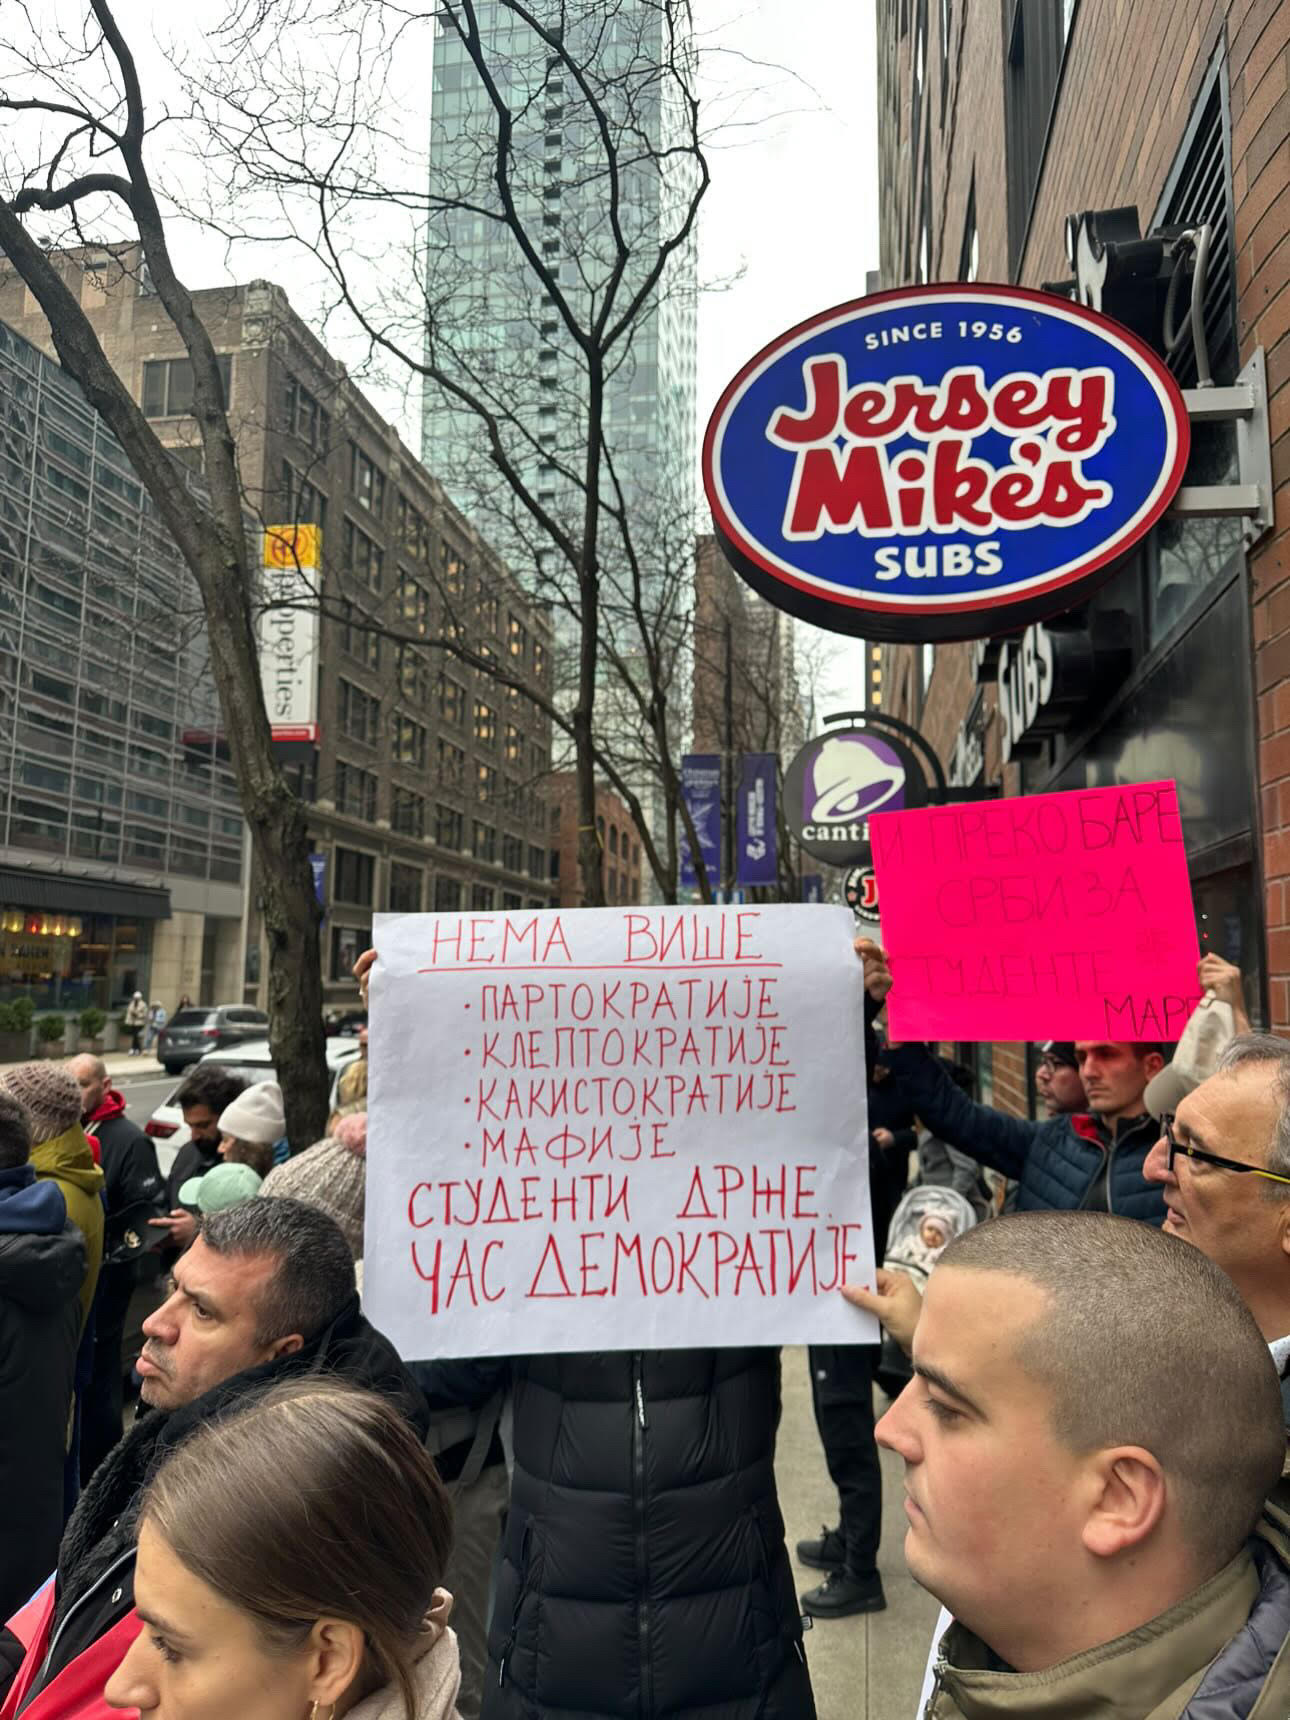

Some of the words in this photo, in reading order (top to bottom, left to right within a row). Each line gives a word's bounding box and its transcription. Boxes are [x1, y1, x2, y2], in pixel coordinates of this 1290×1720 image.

[864, 321, 943, 351] SINCE
[958, 320, 1023, 344] 1956
[769, 356, 1112, 456] Jersey
[786, 438, 1109, 537] Mike's
[874, 541, 1003, 581] SUBS
[928, 803, 1069, 865] ПРЕКО
[1077, 788, 1184, 851] БАРЕ
[935, 873, 1070, 929] СРБИ
[1082, 866, 1149, 917] ЗА
[431, 917, 572, 964] НЕМА
[623, 911, 764, 963] ВИШЕ
[481, 975, 780, 1023] ПАРТОКРАТИЈЕ
[482, 1022, 790, 1069] КЛЕПТОКРАТИЈЕ
[476, 1070, 797, 1122] КАКИСТОКРАТИЈЕ
[481, 1117, 678, 1169] МАФИЈЕ
[407, 1173, 631, 1229] СТУДЕНТИ
[409, 1238, 507, 1316] ЧАС
[523, 1222, 871, 1300] ДЕМОКРАТИЈЕ
